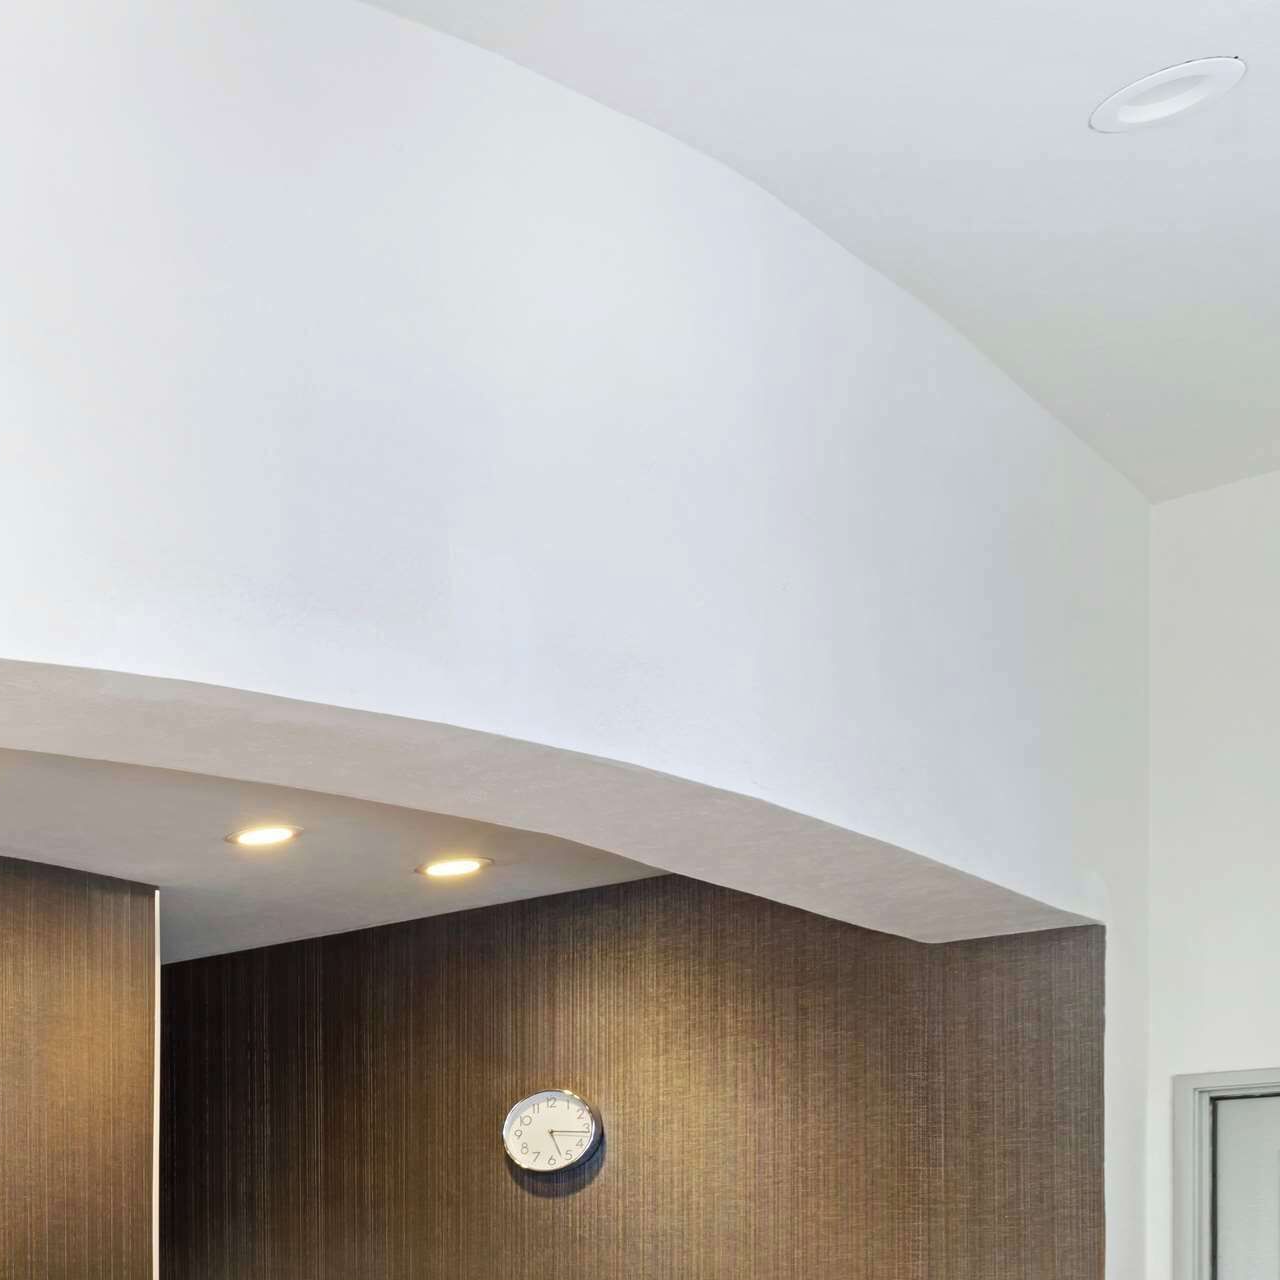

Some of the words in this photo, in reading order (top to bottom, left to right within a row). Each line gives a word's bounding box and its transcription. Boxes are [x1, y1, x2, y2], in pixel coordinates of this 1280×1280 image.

[545, 1096, 557, 1108] 12
[532, 1103, 540, 1114] 11
[576, 1109, 584, 1120] 2
[519, 1115, 533, 1127] 10
[583, 1122, 590, 1133] 3
[514, 1129, 523, 1139] 9
[575, 1138, 584, 1147] 4
[520, 1142, 529, 1155] 8
[532, 1151, 541, 1162] 7
[547, 1155, 557, 1166] 6
[565, 1149, 573, 1161] 5
